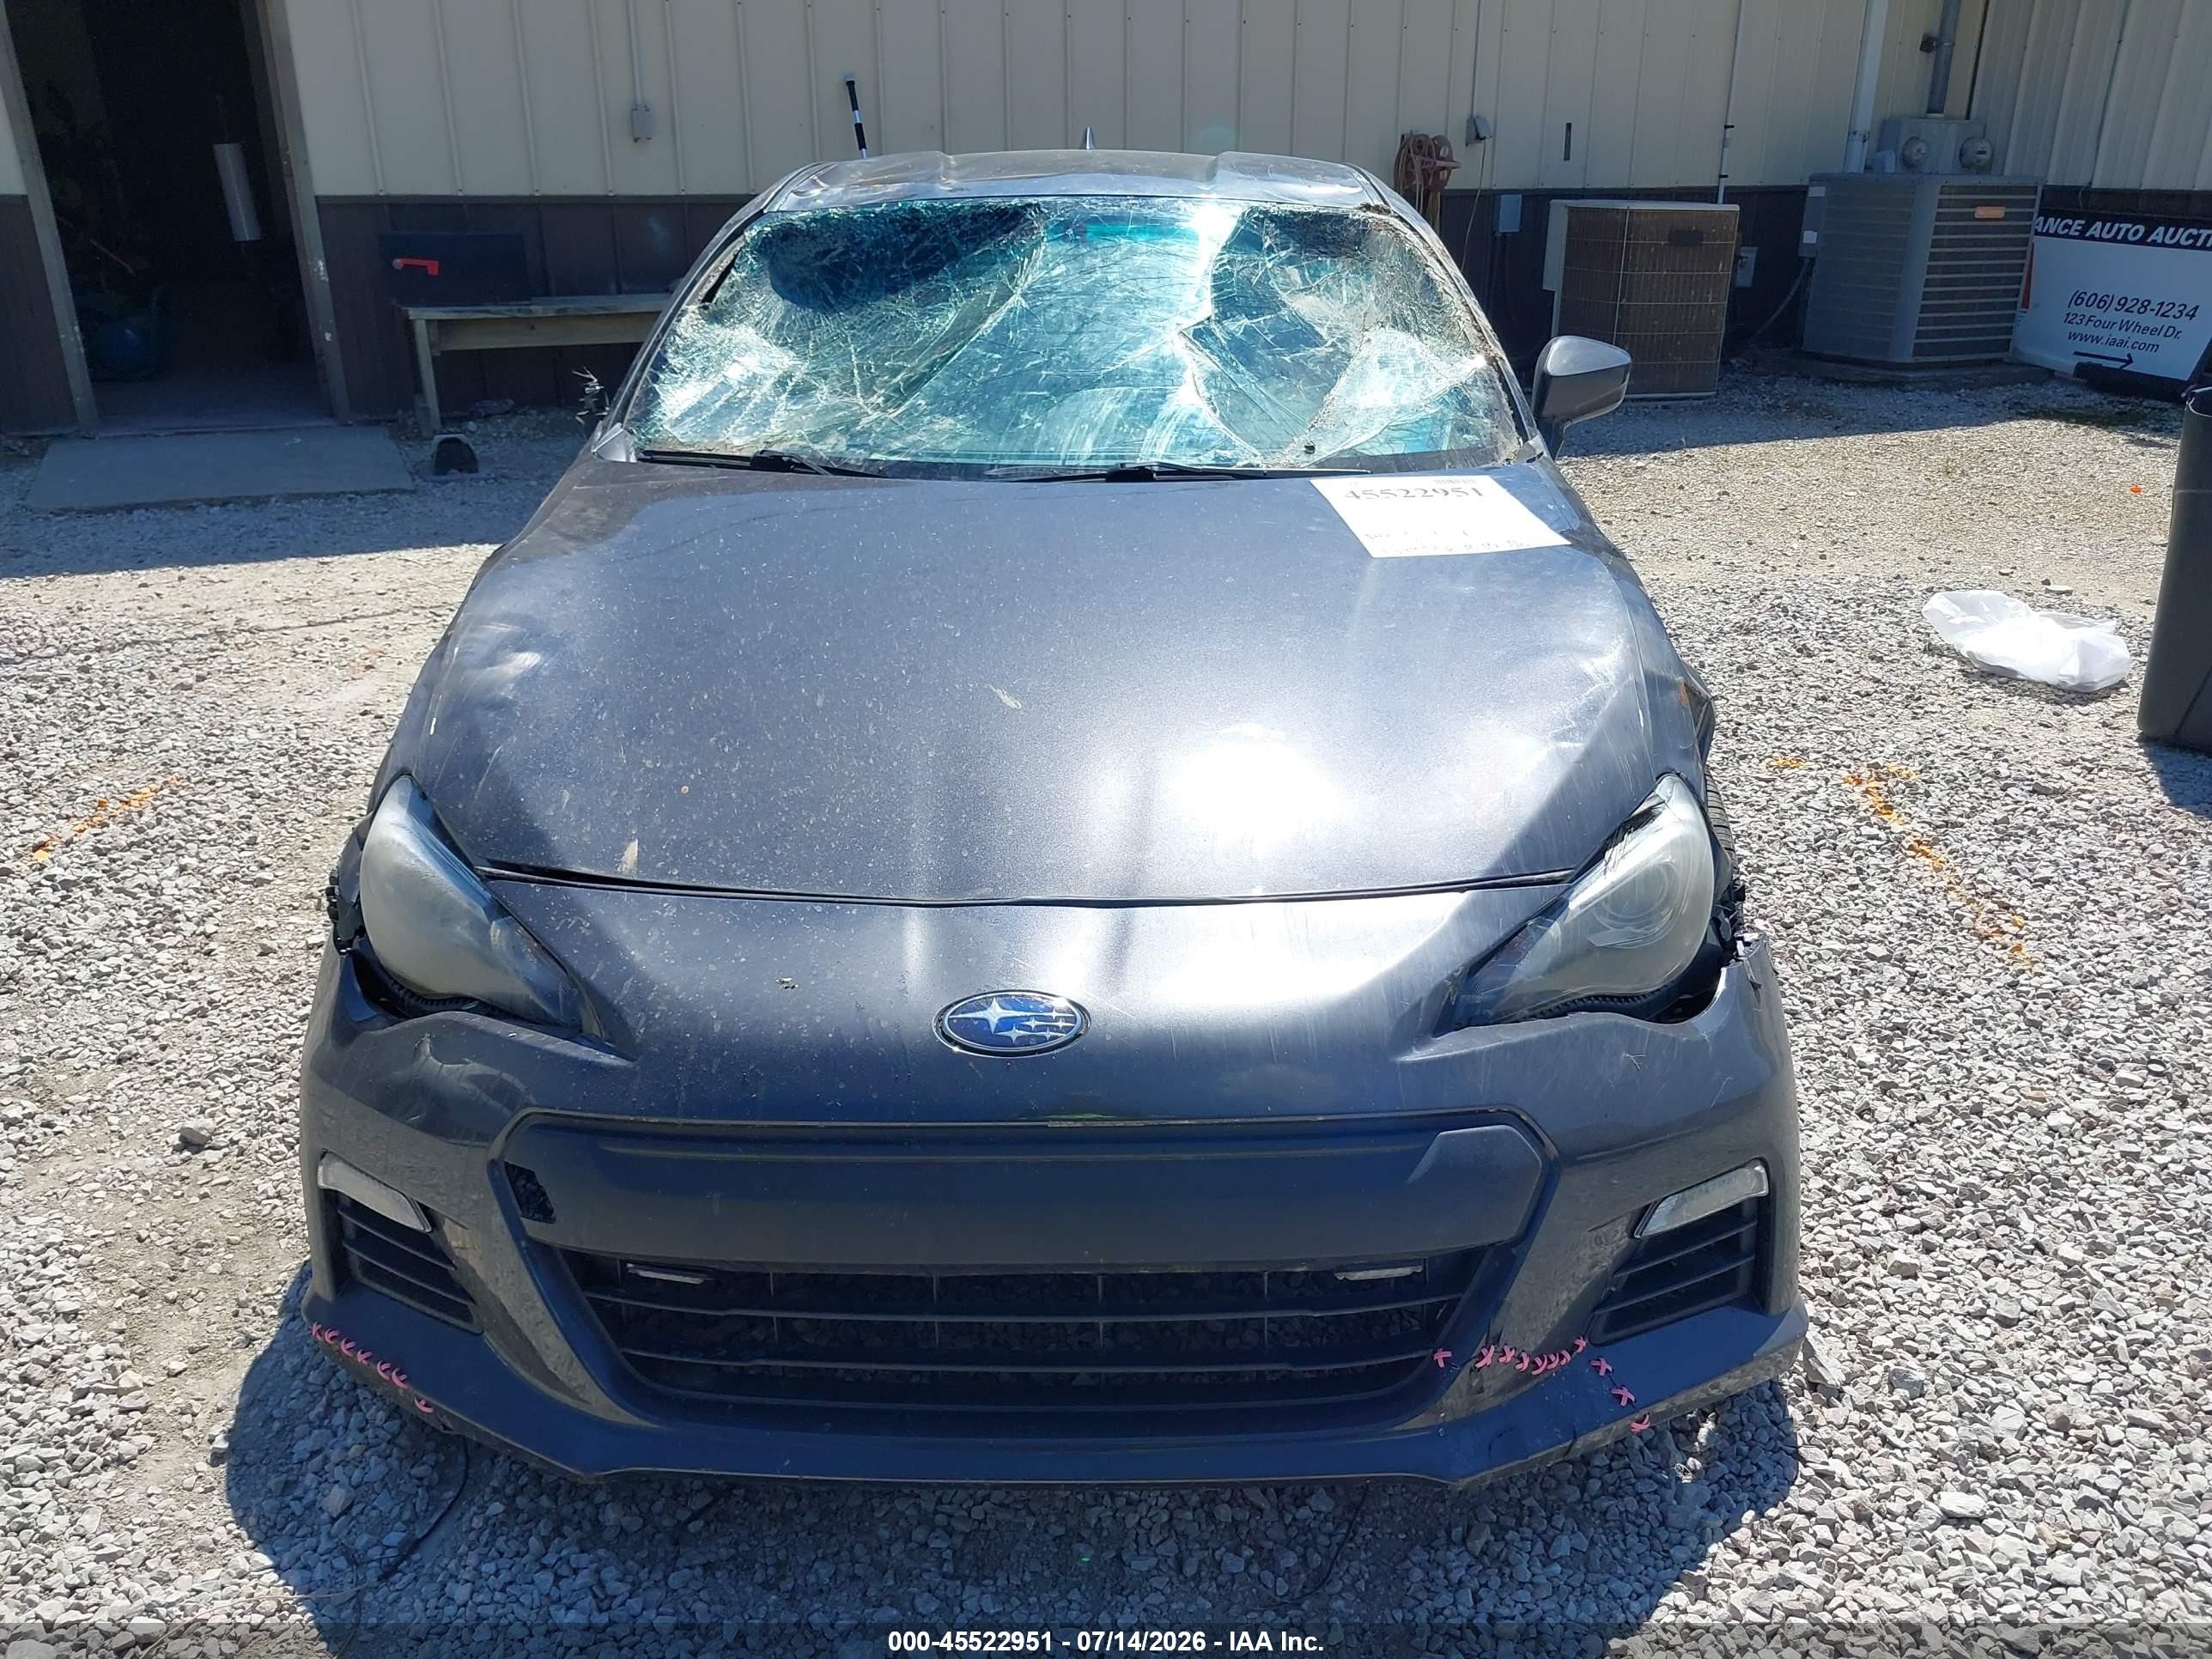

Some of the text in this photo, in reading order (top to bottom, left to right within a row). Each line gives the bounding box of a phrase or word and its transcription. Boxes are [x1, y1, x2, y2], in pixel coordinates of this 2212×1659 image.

[2034, 216, 2086, 236] ANCE
[2085, 221, 2145, 241] AUTO
[2068, 289, 2199, 321] (606) 928-1234
[2063, 312, 2183, 340] 123 Four Wheel Dr.
[2067, 331, 2160, 353] www.iaai.com
[1345, 486, 1485, 500] 45522951
